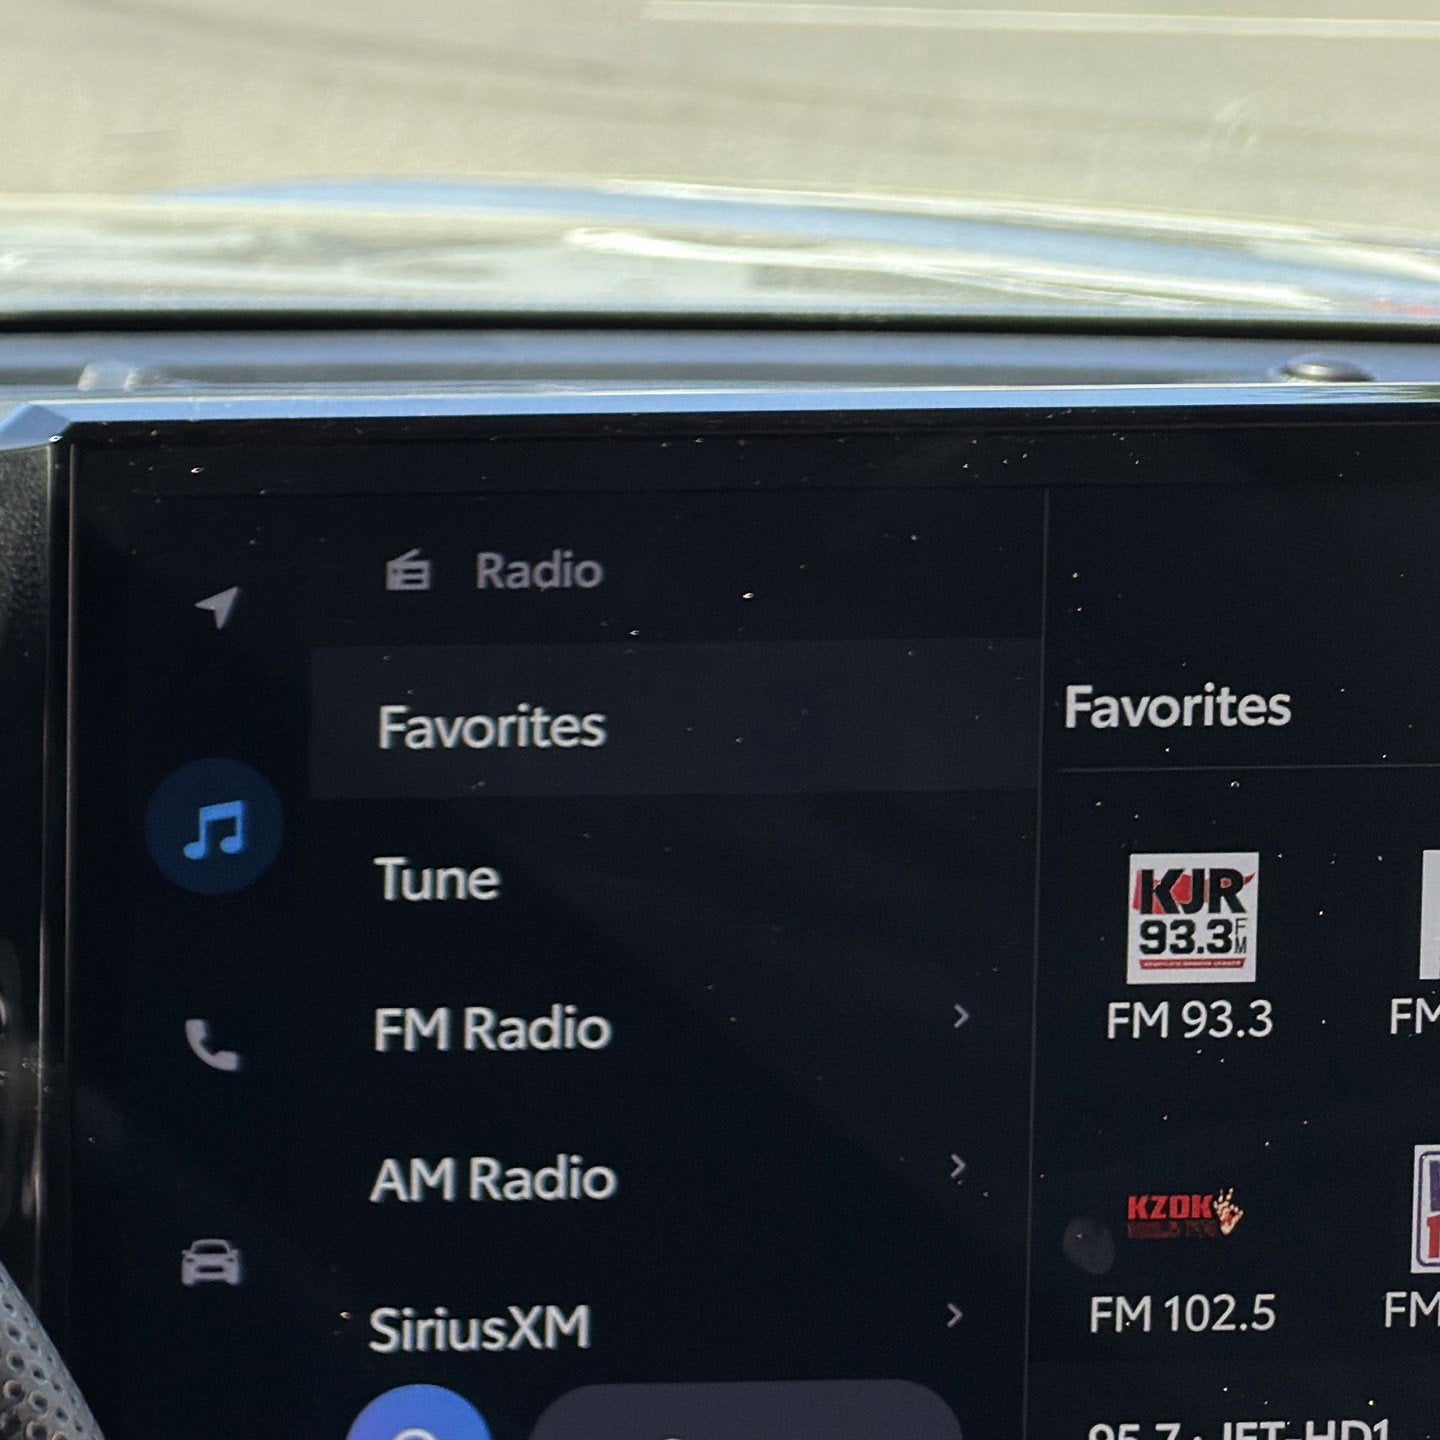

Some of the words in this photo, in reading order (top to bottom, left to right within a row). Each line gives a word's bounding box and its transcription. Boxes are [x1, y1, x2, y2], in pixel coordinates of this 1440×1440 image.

[477, 549, 603, 591] Radio
[379, 703, 606, 750] Favorites
[1065, 682, 1292, 729] Favorites
[374, 856, 500, 901] Tune
[1139, 867, 1247, 914] KJR
[1139, 918, 1233, 955] 93.3
[374, 1008, 450, 1053] FM
[465, 1005, 612, 1052] Radio
[1107, 1001, 1168, 1039] FM
[1182, 999, 1273, 1039] 93.3
[1390, 997, 1440, 1035] FM
[370, 1158, 456, 1203] AM
[470, 1156, 617, 1202] Radio
[369, 1305, 592, 1354] SiriusXM
[1090, 1295, 1151, 1334] FM
[1163, 1293, 1277, 1332] 102.5
[1384, 1291, 1440, 1328] FM
